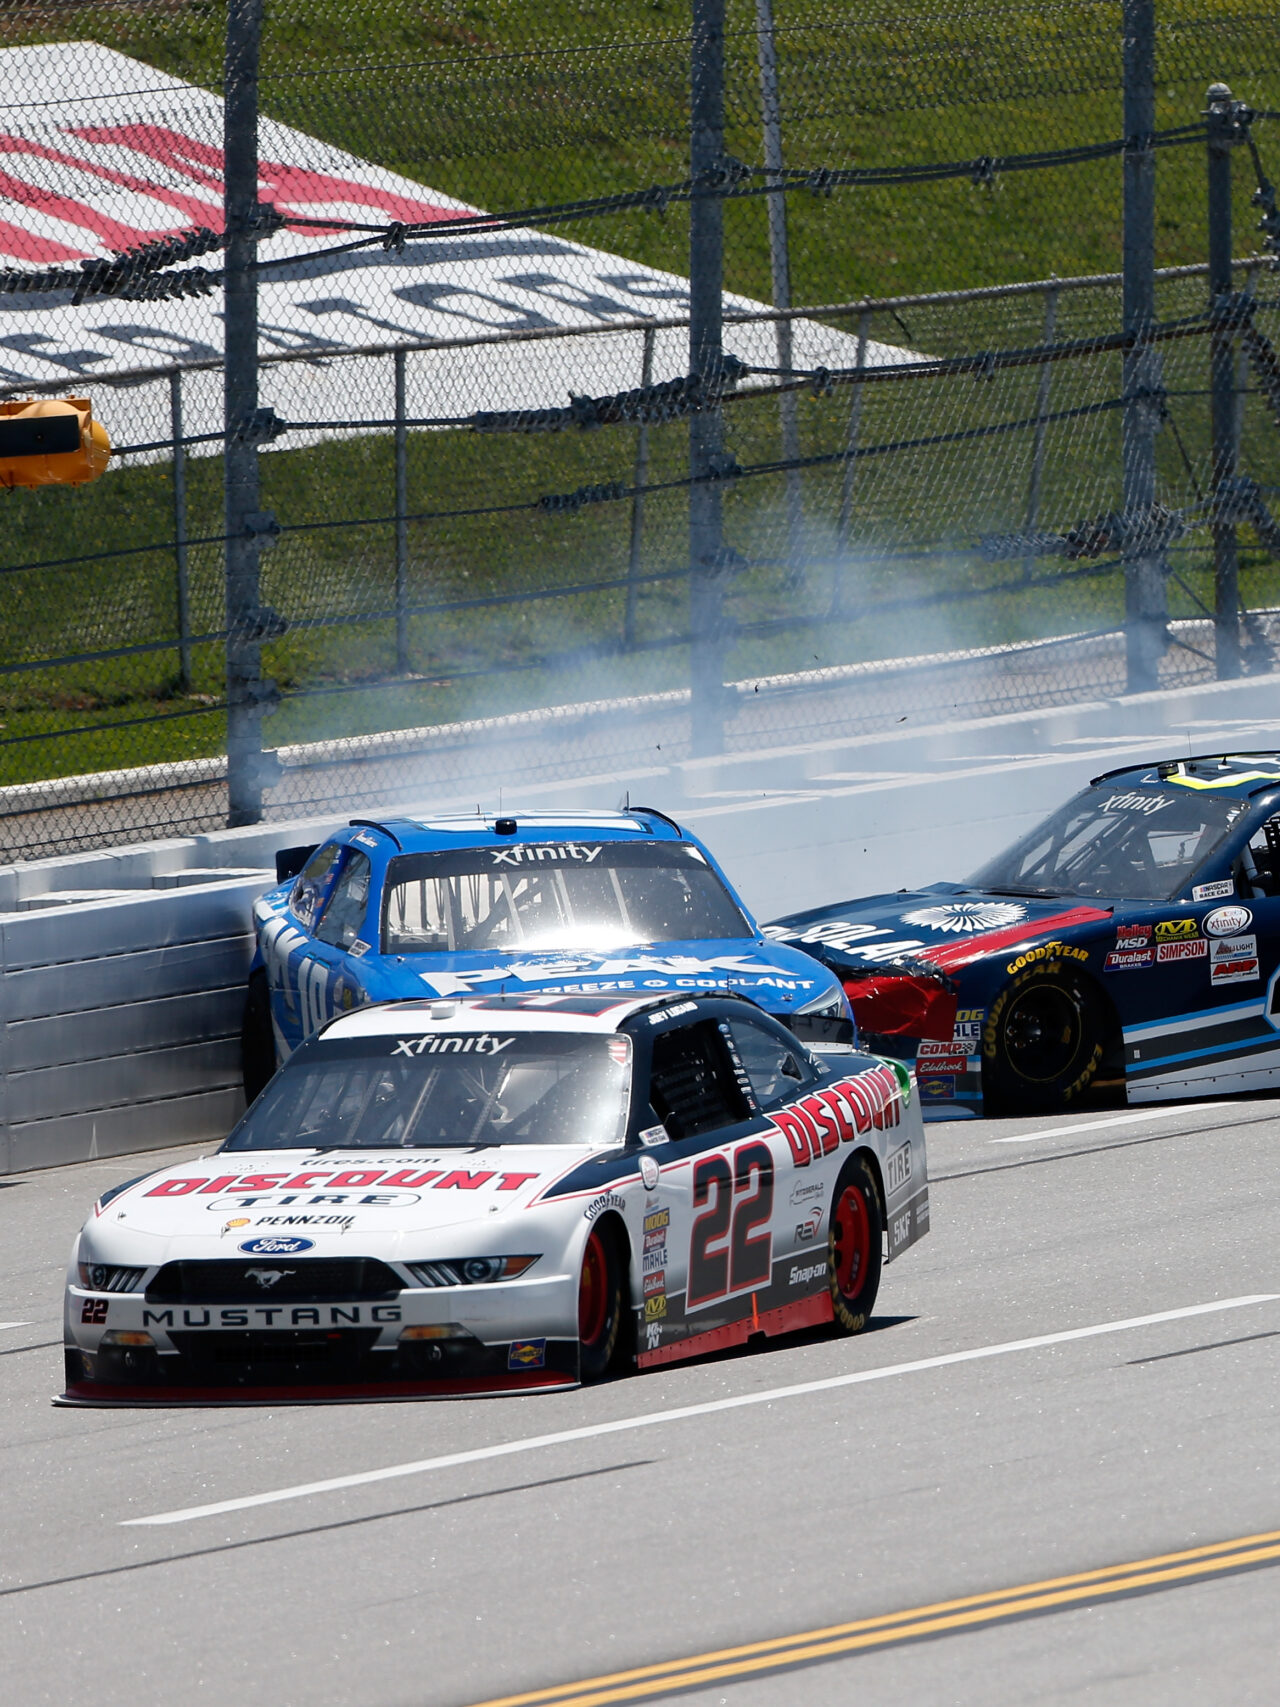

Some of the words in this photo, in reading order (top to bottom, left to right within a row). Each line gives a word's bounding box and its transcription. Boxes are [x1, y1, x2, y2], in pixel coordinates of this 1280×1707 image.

[1097, 791, 1175, 816] xfinity
[491, 844, 602, 866] xfinity
[1200, 890, 1215, 899] RACE
[1217, 888, 1229, 896] CAR
[1206, 881, 1229, 891] NASCAR
[1116, 924, 1152, 940] Holley
[1210, 916, 1242, 931] xfinity
[1115, 937, 1148, 950] MSD
[1159, 940, 1206, 961] SIMPSON
[1236, 943, 1254, 951] LIGHT
[1007, 941, 1089, 974] GOODYEAR
[1109, 950, 1152, 965] Duralast
[420, 955, 800, 997] PEAK
[1213, 959, 1257, 976] ARP
[676, 976, 815, 990] COOLANT
[955, 1008, 985, 1022] OG
[391, 1033, 516, 1057] xfinity
[919, 1042, 963, 1056] COMP
[919, 1057, 963, 1073] Edelbrock
[763, 1064, 900, 1168] DISCOUNT
[300, 1156, 441, 1167] tires.com
[887, 1153, 910, 1191] TIRE
[144, 1169, 541, 1197] DISCOUNT
[234, 1193, 400, 1208] TIRE
[584, 1189, 627, 1223] GOODYEAR
[255, 1215, 355, 1227] PENNZOIL
[645, 1211, 669, 1233] MOOG
[687, 1139, 775, 1311] 22
[894, 1210, 911, 1246] SKF
[251, 1237, 302, 1253] Ford
[645, 1230, 666, 1248] Duralast
[643, 1249, 668, 1273] MAHLE
[788, 1262, 827, 1286] Snap-on
[643, 1275, 665, 1292] Edelbrock
[81, 1298, 109, 1324] 22
[142, 1305, 403, 1328] MUSTANG
